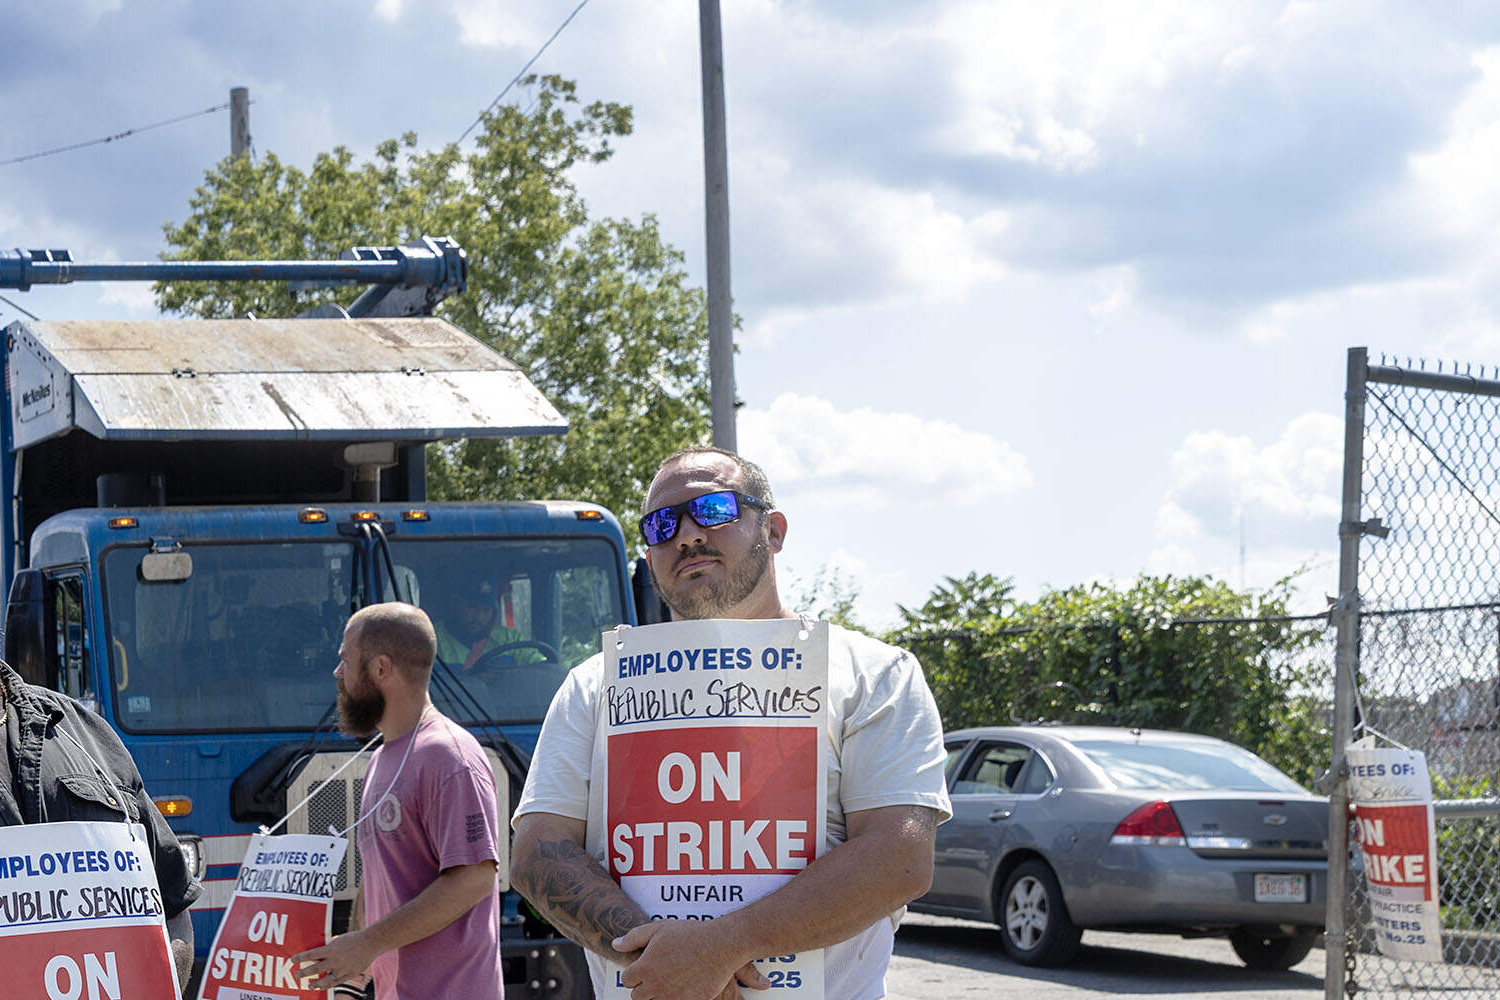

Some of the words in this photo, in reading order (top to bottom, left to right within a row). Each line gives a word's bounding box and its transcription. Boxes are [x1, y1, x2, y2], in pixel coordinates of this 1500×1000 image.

[618, 648, 752, 679] EMPLOYEES
[761, 647, 803, 670] OF:
[606, 685, 696, 726] REPUBLIC
[706, 679, 822, 717] SERVICES
[657, 751, 741, 804] ON
[1391, 763, 1415, 776] OF:
[114, 850, 142, 872] OF:
[255, 851, 308, 866] EMPLOYEES
[310, 852, 329, 867] OF:
[612, 819, 808, 875] STRIKE
[282, 869, 337, 898] SERVICES
[661, 885, 744, 903] UNFAIR
[78, 886, 164, 917] SERVICES
[248, 910, 288, 945] ON
